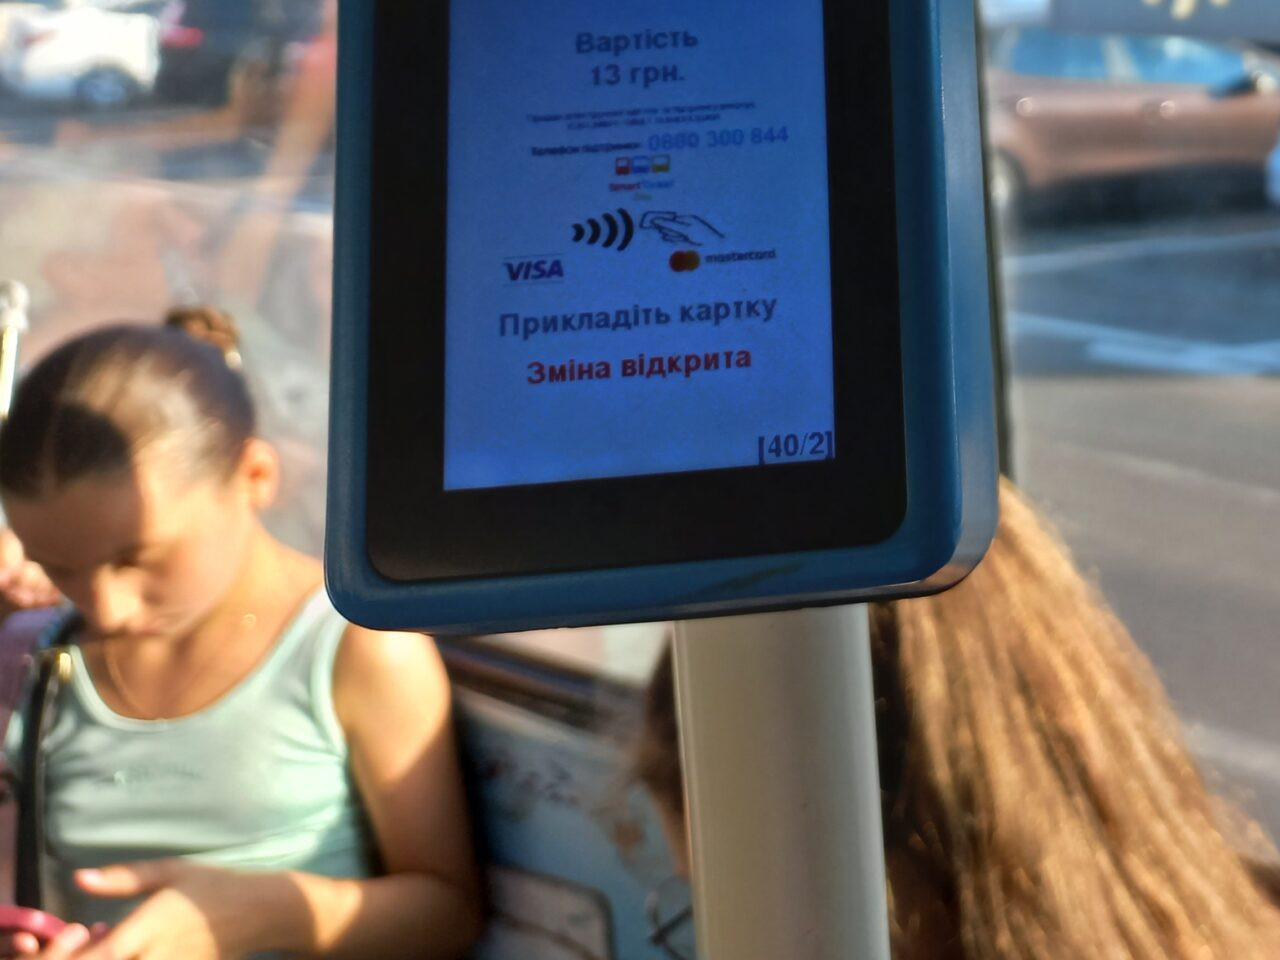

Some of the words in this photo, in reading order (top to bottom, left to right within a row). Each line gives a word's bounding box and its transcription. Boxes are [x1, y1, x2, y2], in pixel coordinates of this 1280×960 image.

[576, 29, 698, 56] Вартість
[591, 64, 621, 86] 13
[630, 63, 686, 89] грн.
[707, 129, 745, 148] 300
[751, 126, 789, 144] 844
[505, 258, 563, 281] VISA
[706, 249, 777, 264] mastercard
[500, 303, 670, 340] Прикладіть
[679, 298, 777, 327] картку
[527, 359, 611, 385] Зміна
[621, 349, 752, 380] відкрита
[758, 431, 834, 465] [40/2]
